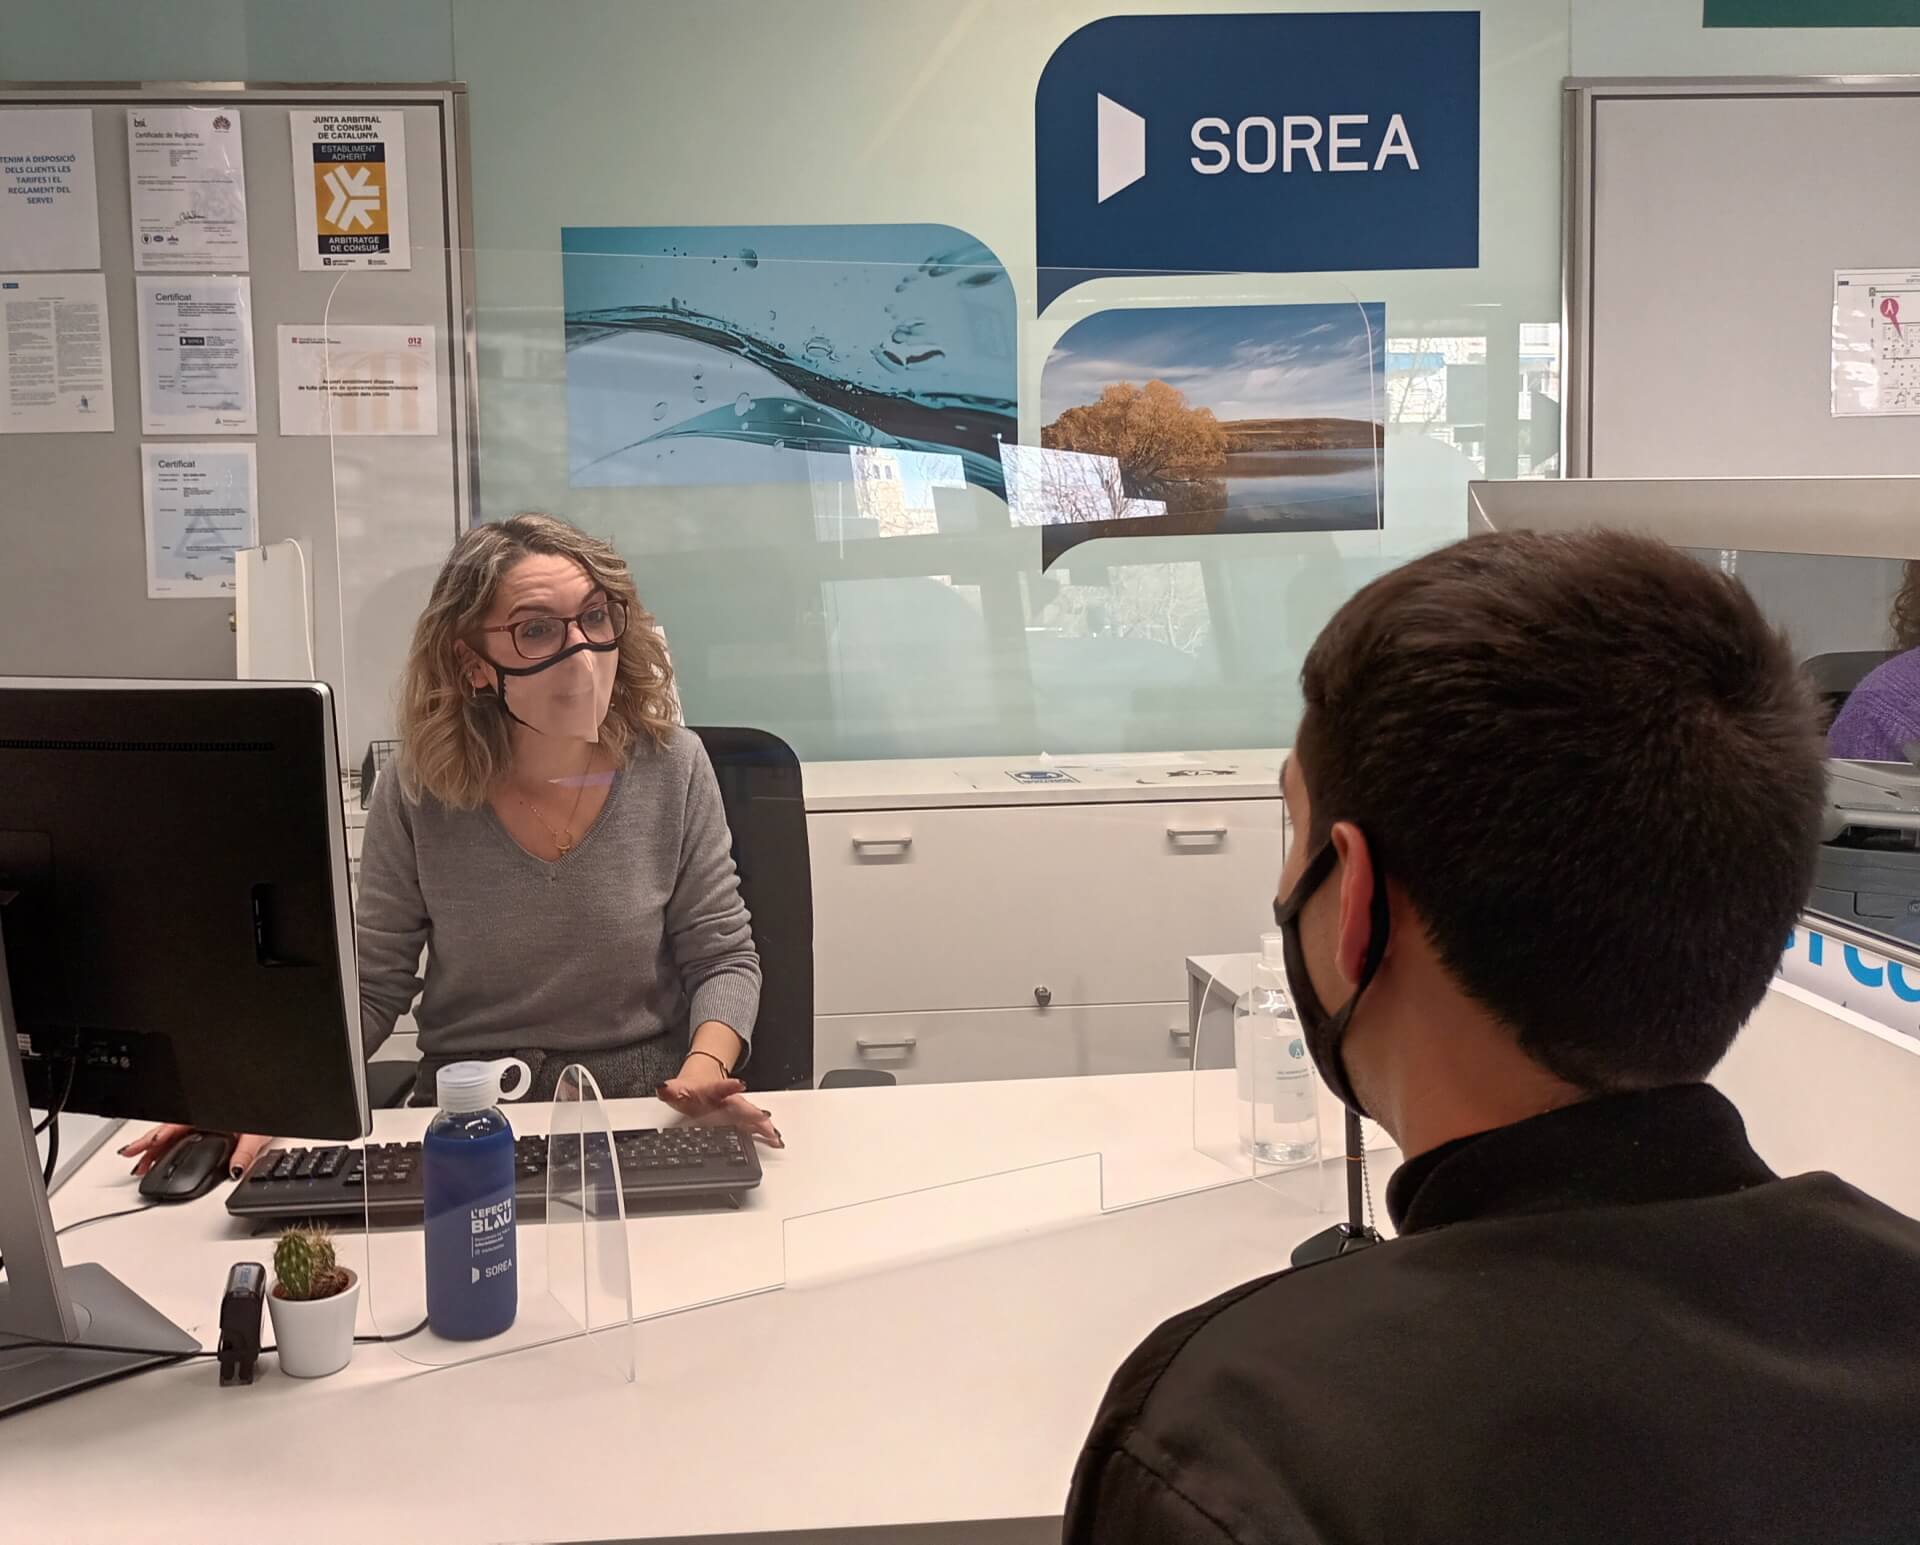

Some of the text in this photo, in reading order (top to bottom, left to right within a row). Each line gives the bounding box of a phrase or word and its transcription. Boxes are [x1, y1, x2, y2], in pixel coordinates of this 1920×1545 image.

[321, 145, 377, 153] ESTABLIMENT
[1190, 114, 1420, 175] SOREA
[32, 154, 76, 163] DISPOSICIÓ
[331, 153, 367, 161] ADHERIT
[155, 293, 192, 301] Certificat
[408, 337, 422, 345] 012
[158, 460, 196, 469] Certificat
[472, 1208, 512, 1234] BLAU
[485, 1258, 513, 1278] SOREA
